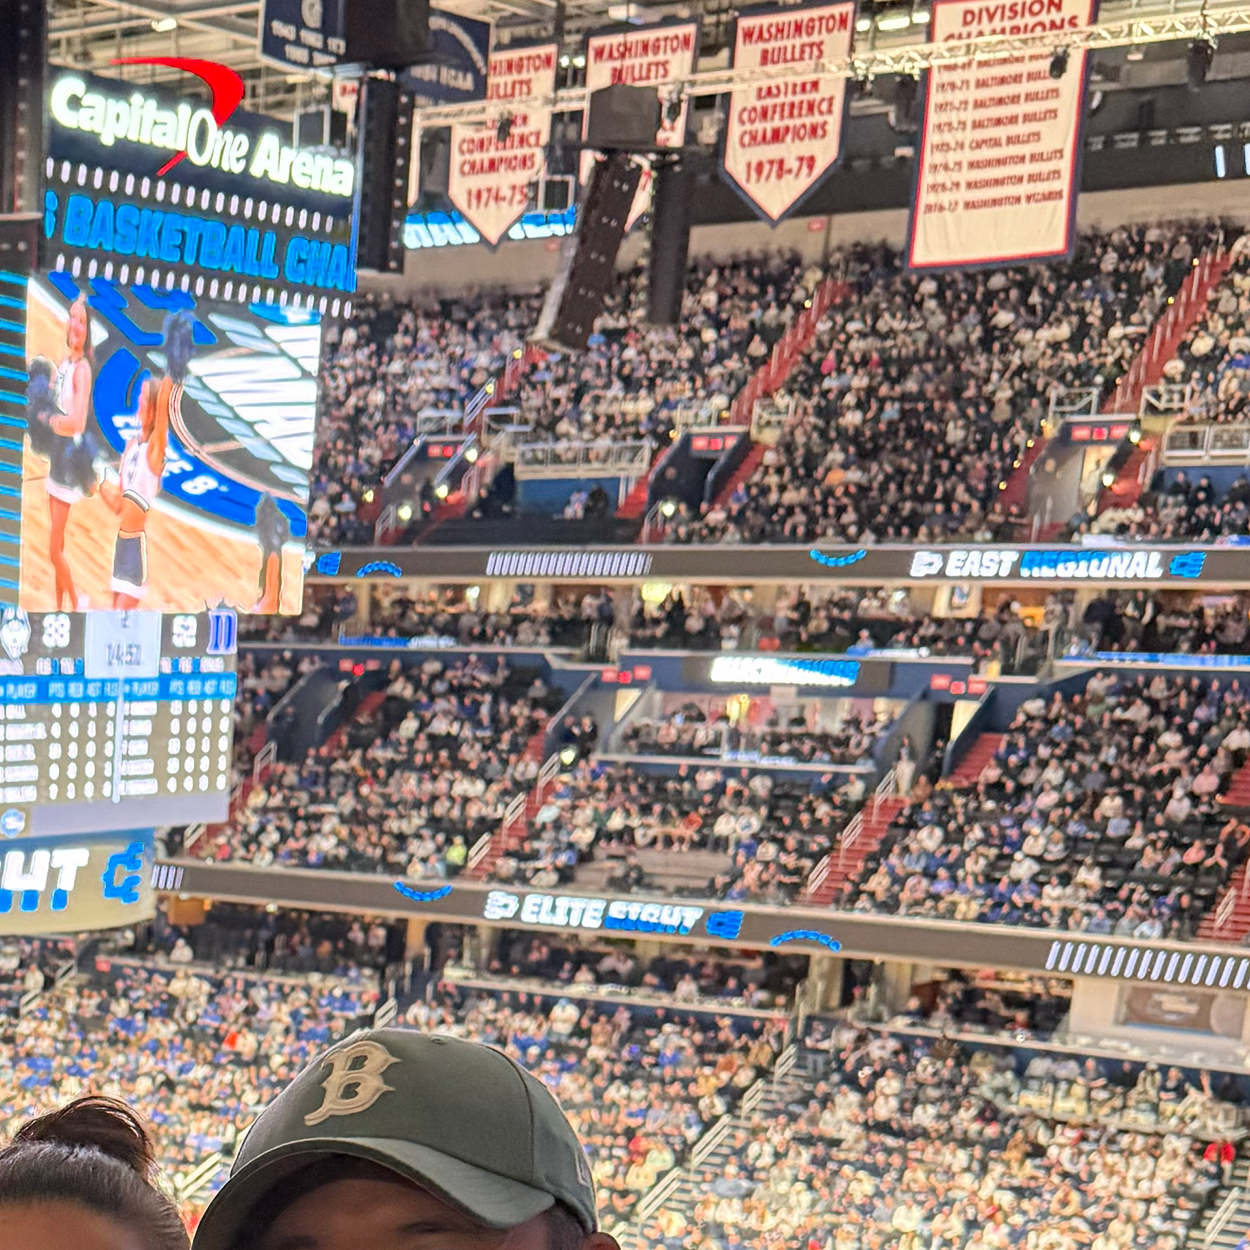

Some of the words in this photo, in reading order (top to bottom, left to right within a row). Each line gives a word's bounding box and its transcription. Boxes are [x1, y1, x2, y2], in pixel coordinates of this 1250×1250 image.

[962, 0, 1063, 27] DIVISION
[741, 11, 849, 46] WASHINGTON
[593, 33, 692, 64] WASHINGTON
[760, 40, 824, 66] BULLETS
[489, 53, 553, 76] HINGTON
[610, 60, 670, 85] BULLETS
[1026, 69, 1051, 84] BULL
[738, 94, 835, 126] CONFERENCE
[1024, 88, 1060, 104] BULLETS
[1021, 109, 1059, 124] BULLETS
[738, 120, 828, 149] CHAMPIONS
[1005, 131, 1041, 147] BULLETS
[249, 131, 355, 197] Arena
[459, 153, 536, 177] CHAMPIONS
[744, 154, 817, 184] 1978-79
[63, 193, 279, 279] BASKETBALL
[283, 236, 357, 292] CHA
[946, 550, 1019, 577] EAST
[1020, 551, 1164, 578] REGIONAL
[521, 893, 607, 928] ELITE
[303, 1040, 402, 1127] B
